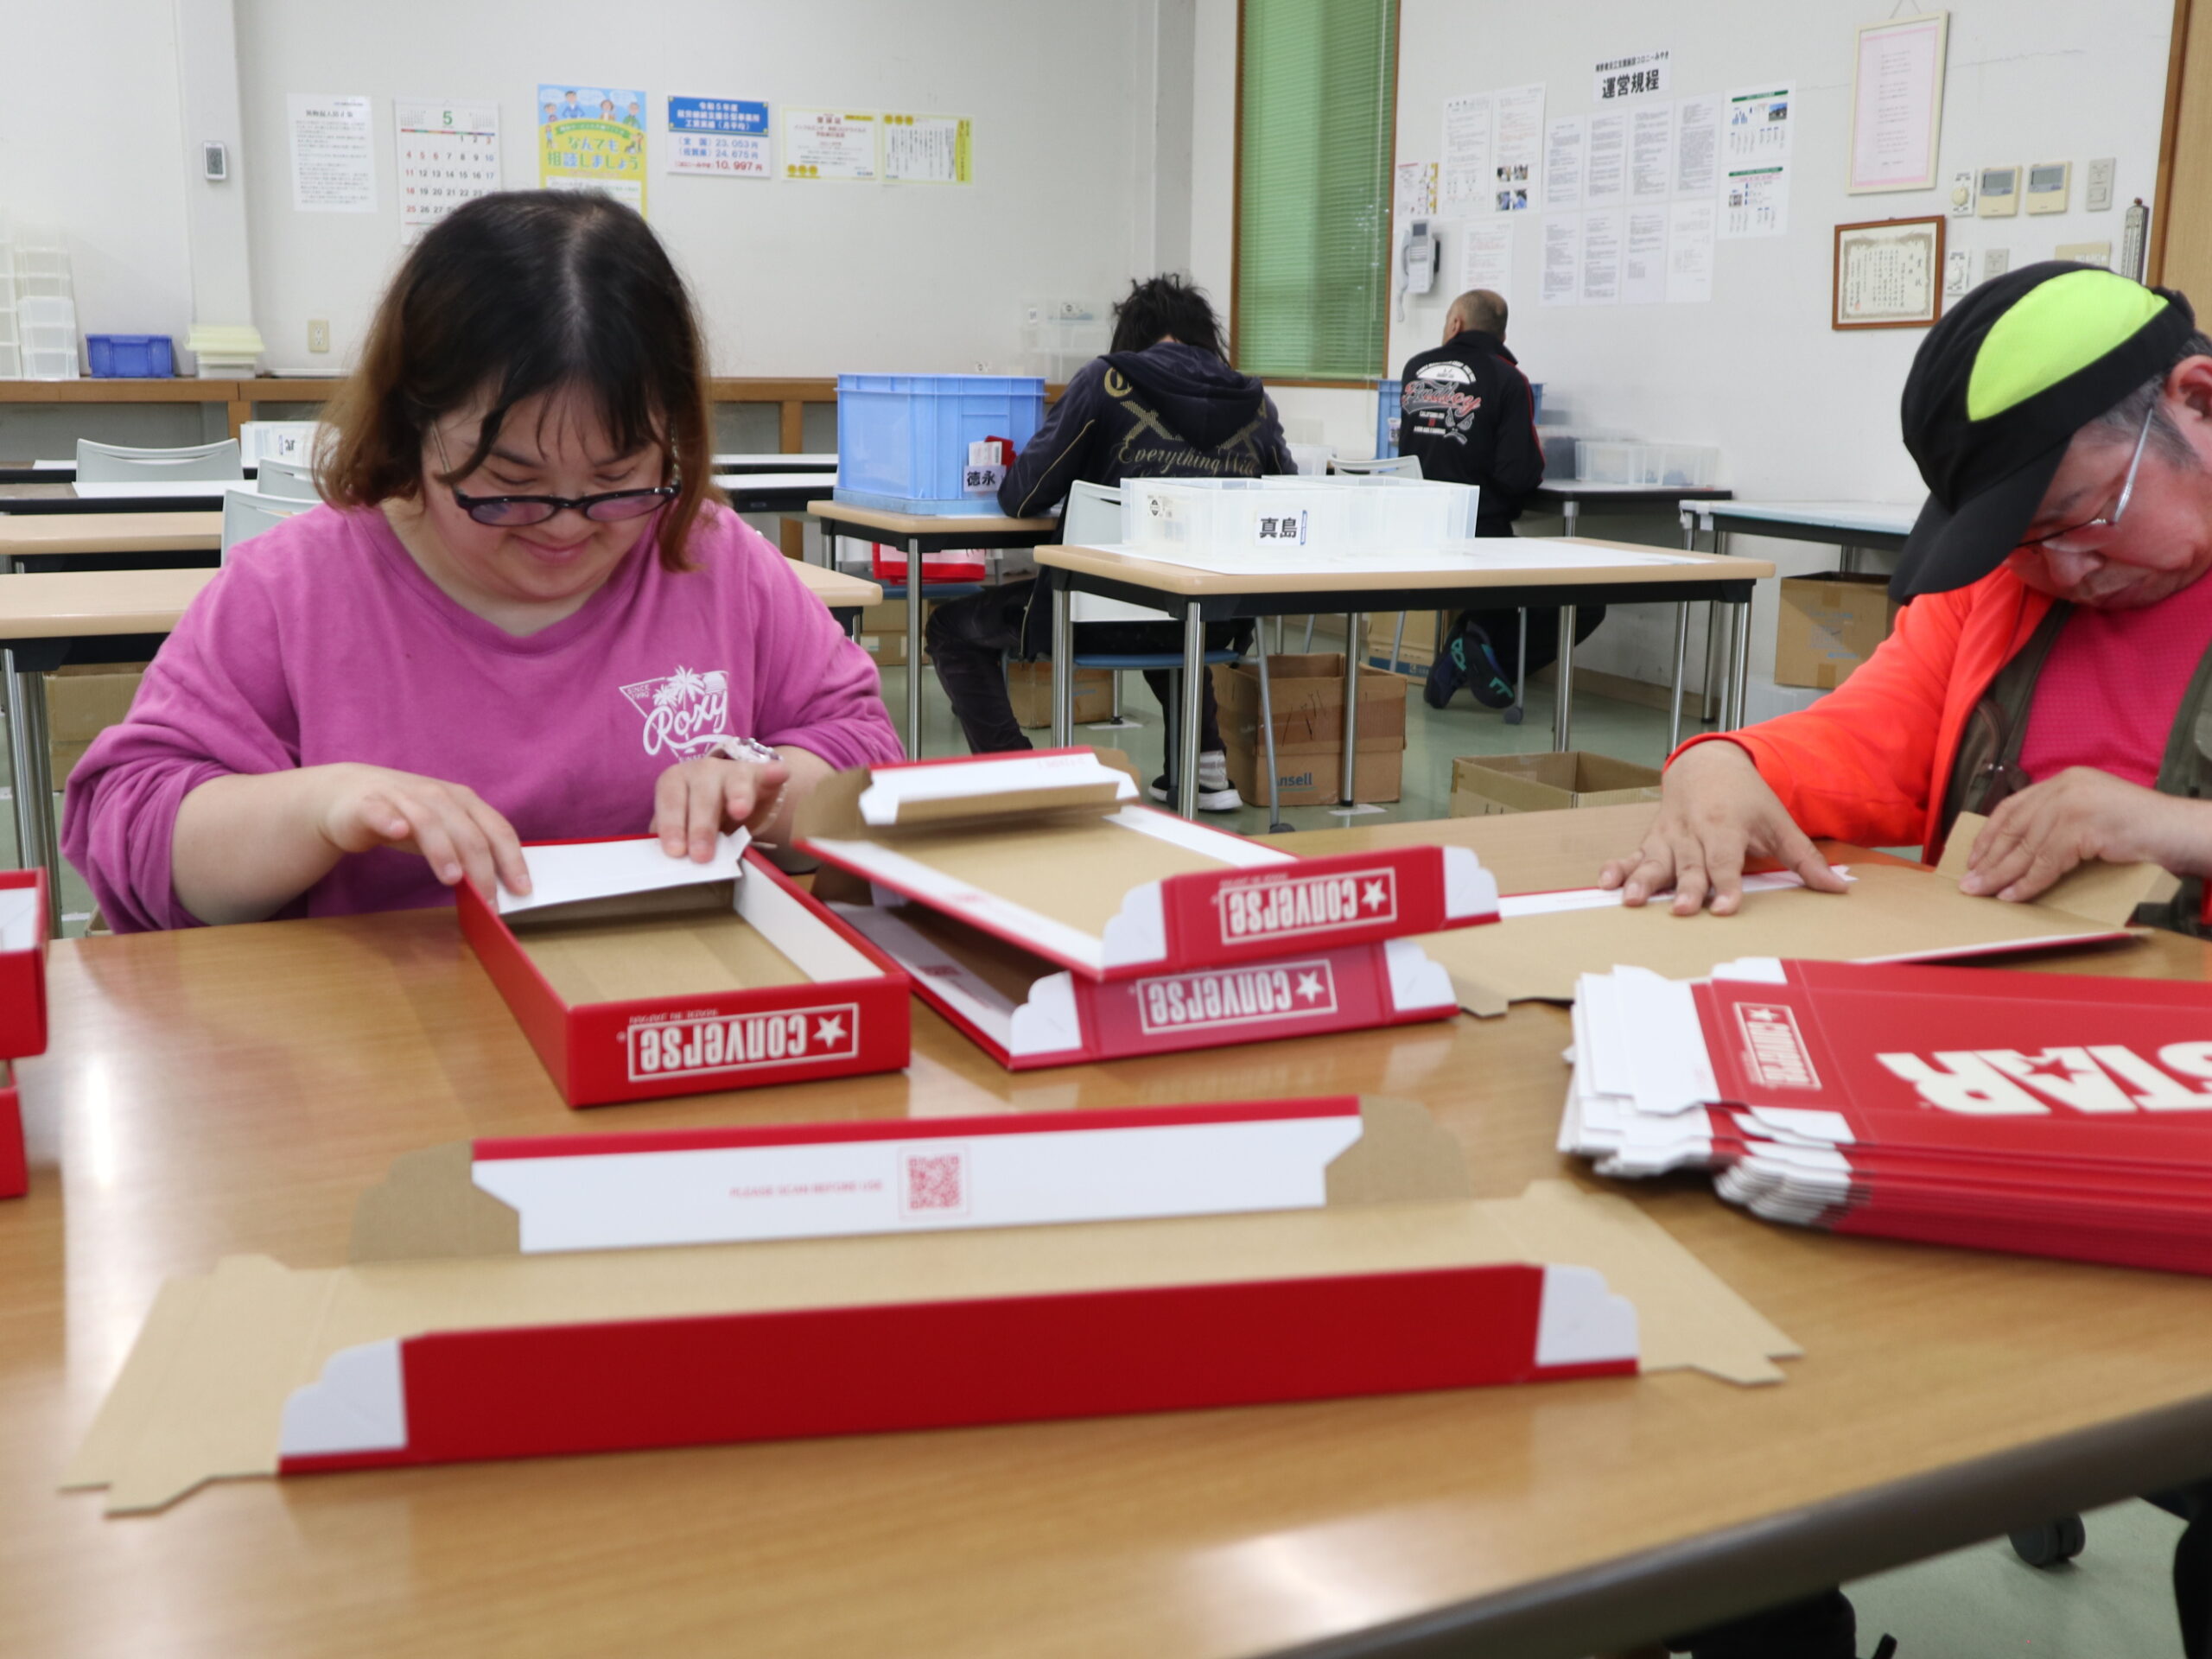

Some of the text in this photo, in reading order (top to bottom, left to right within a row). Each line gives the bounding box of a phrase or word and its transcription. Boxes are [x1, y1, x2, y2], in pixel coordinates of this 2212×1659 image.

[1602, 68, 1660, 99] 運営規程
[442, 110, 453, 125] 5
[569, 136, 619, 154] なんでも
[547, 150, 639, 170] 相談しましょう
[967, 470, 996, 486] 徳永
[1260, 517, 1297, 539] 真島
[643, 693, 734, 755] Roxy
[1276, 772, 1313, 787] nsell
